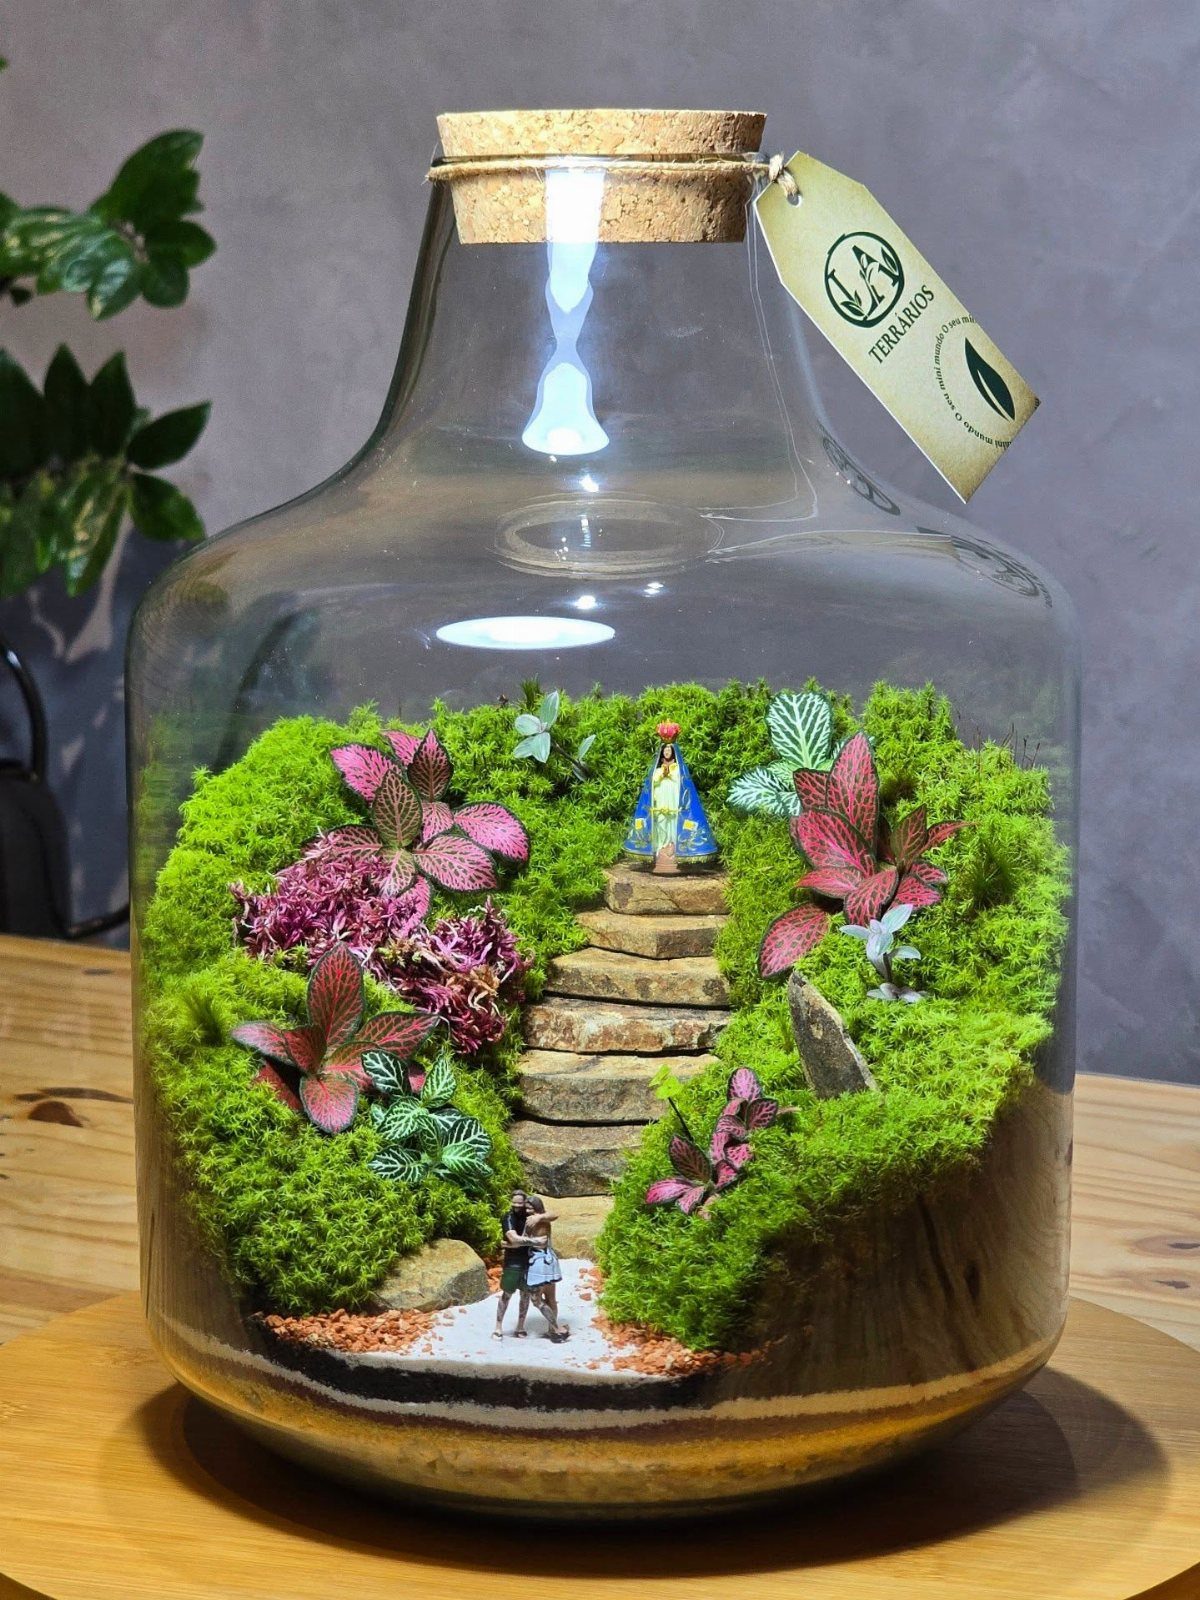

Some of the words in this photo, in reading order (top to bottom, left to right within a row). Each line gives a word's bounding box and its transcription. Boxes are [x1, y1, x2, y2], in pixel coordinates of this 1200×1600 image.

[868, 284, 934, 364] TERRÁRIOS
[942, 324, 949, 334] O
[948, 320, 961, 329] seu
[934, 332, 945, 365] mundo
[933, 366, 946, 390] mini
[943, 393, 955, 411] seu
[955, 412, 963, 422] O
[963, 421, 993, 445] mundo
